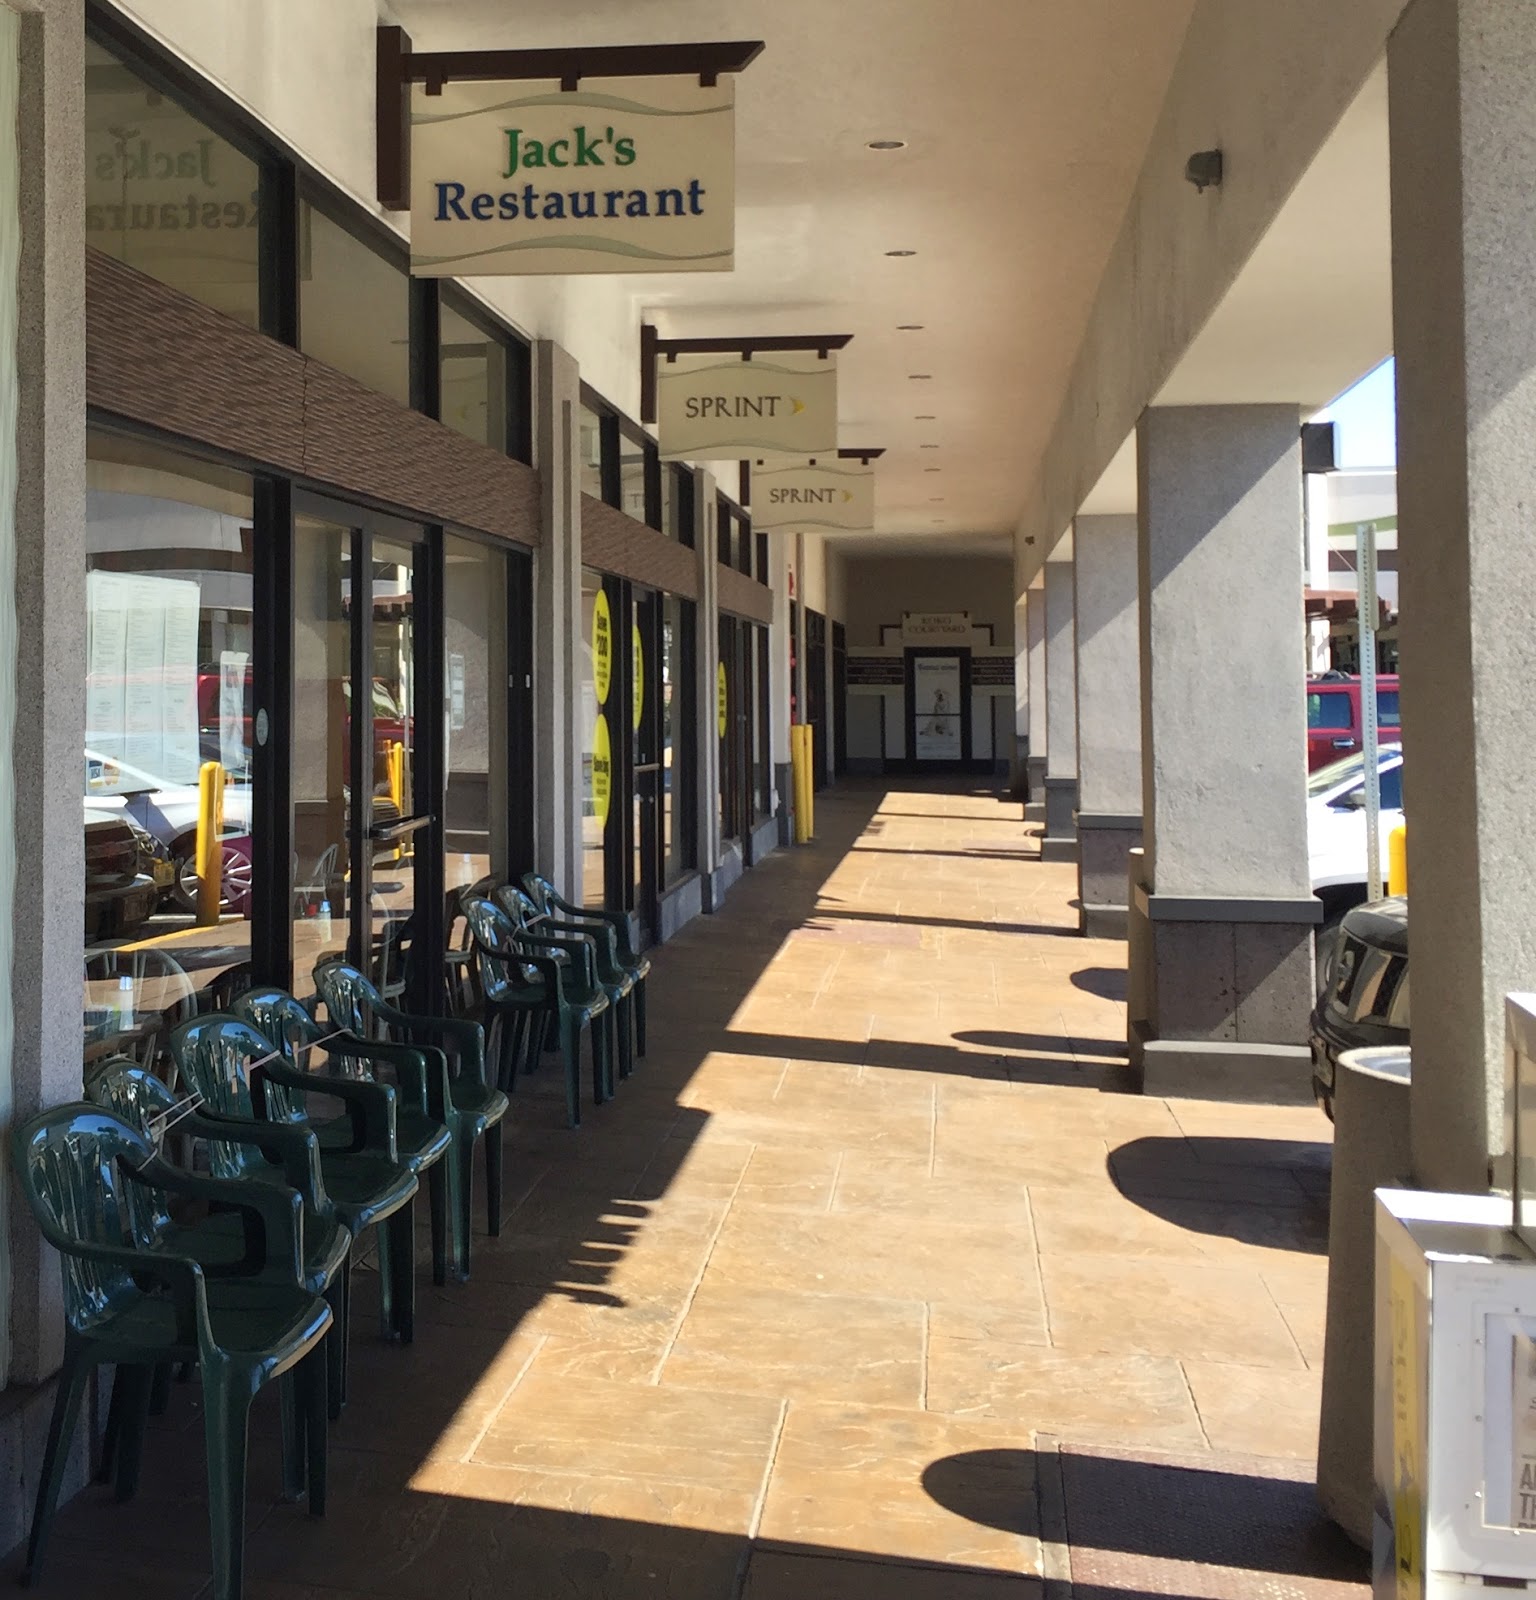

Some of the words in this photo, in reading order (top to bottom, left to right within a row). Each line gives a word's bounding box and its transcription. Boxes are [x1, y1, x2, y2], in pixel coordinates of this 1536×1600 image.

[502, 126, 637, 179] Jack's
[434, 179, 706, 222] Restaurant
[685, 395, 782, 418] SPRINT
[769, 487, 837, 504] SPRINT
